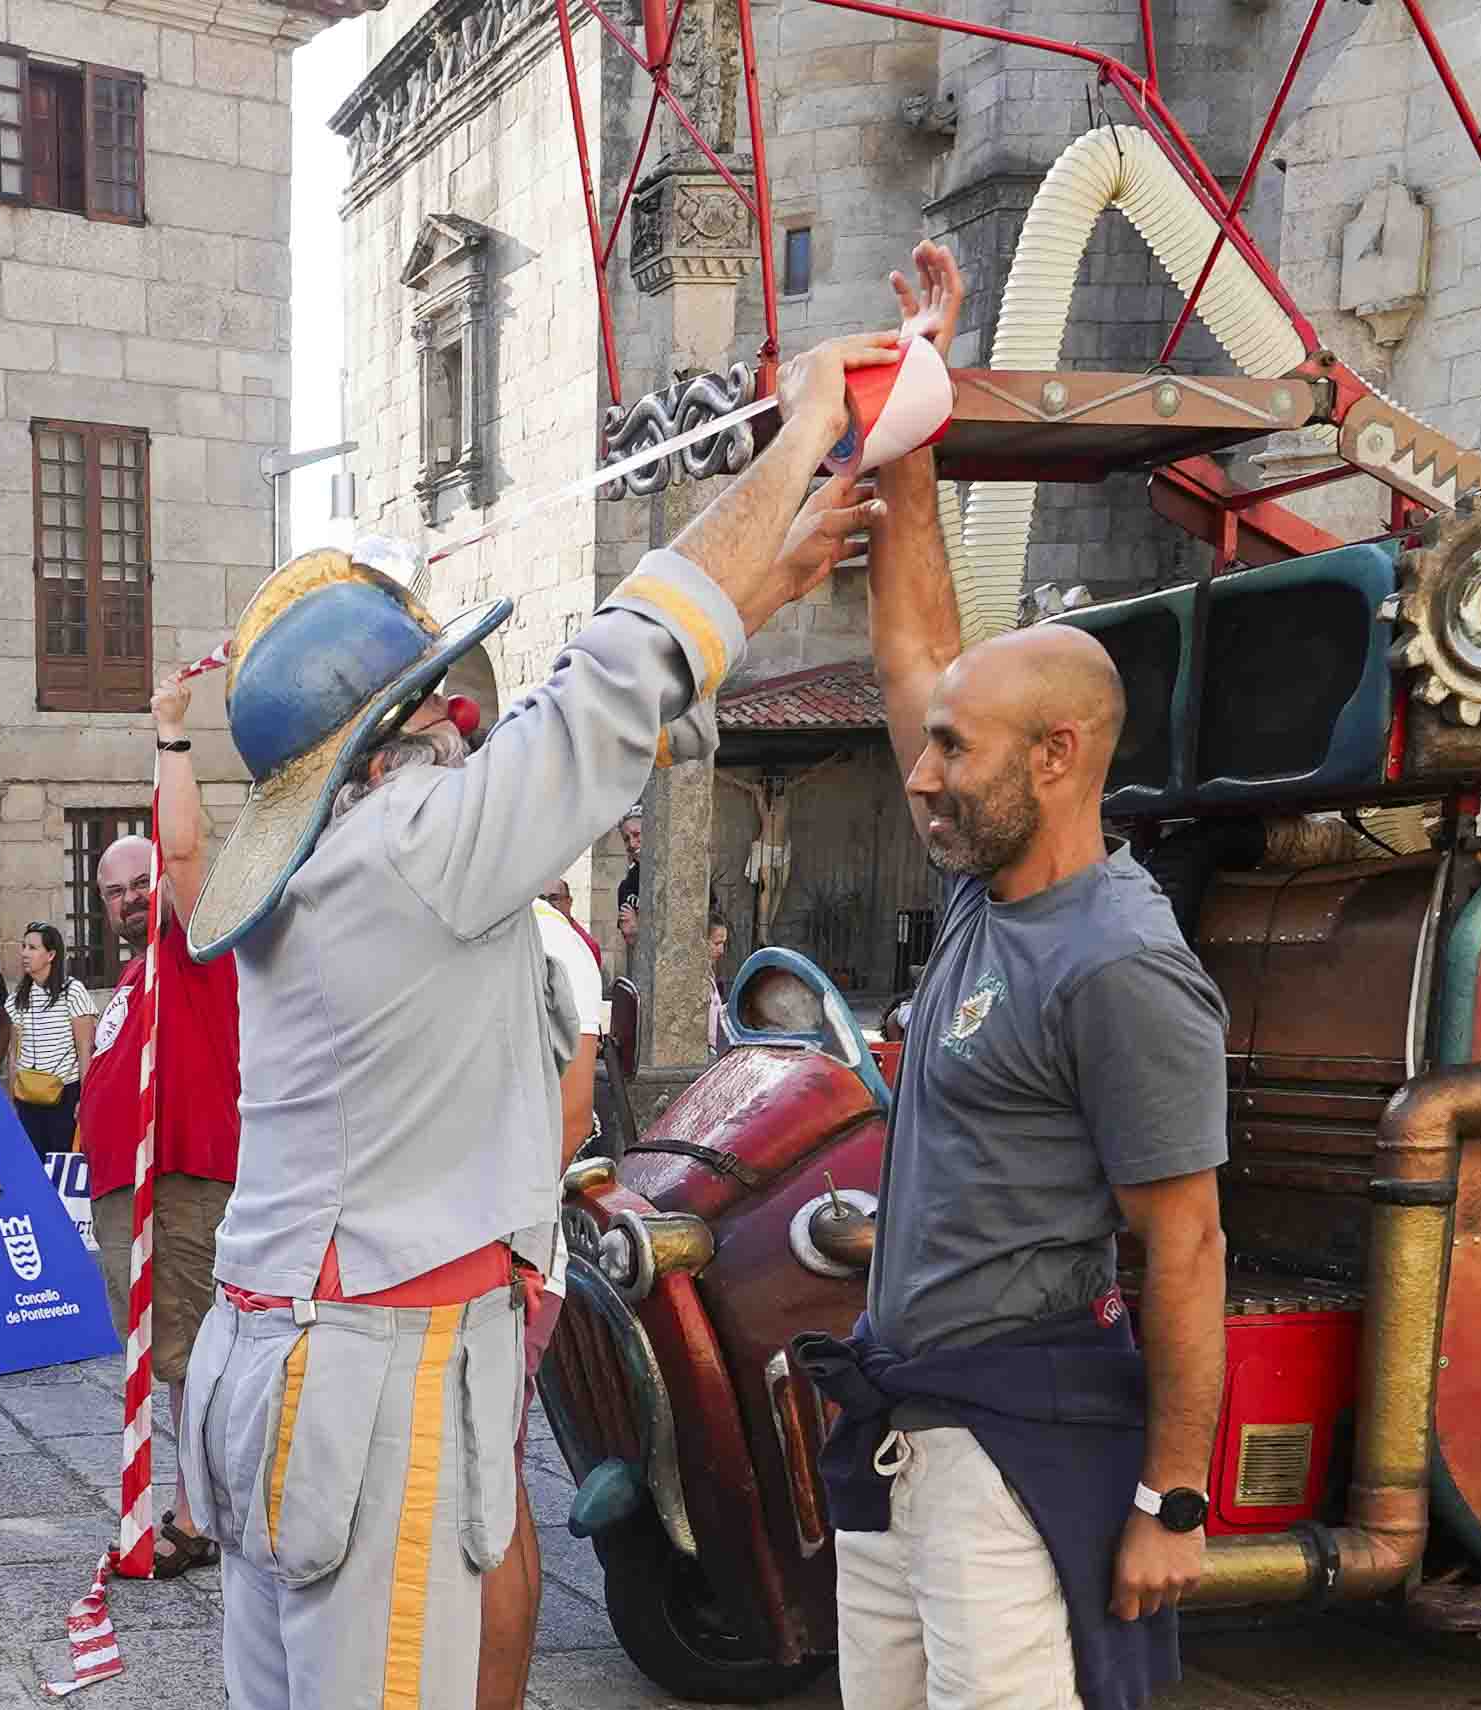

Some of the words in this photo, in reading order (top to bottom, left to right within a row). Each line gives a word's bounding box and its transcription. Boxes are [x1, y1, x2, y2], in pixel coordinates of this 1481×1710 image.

[15, 1289, 60, 1307] Concello
[6, 1311, 21, 1324] de
[20, 1302, 80, 1322] Pontevedra
